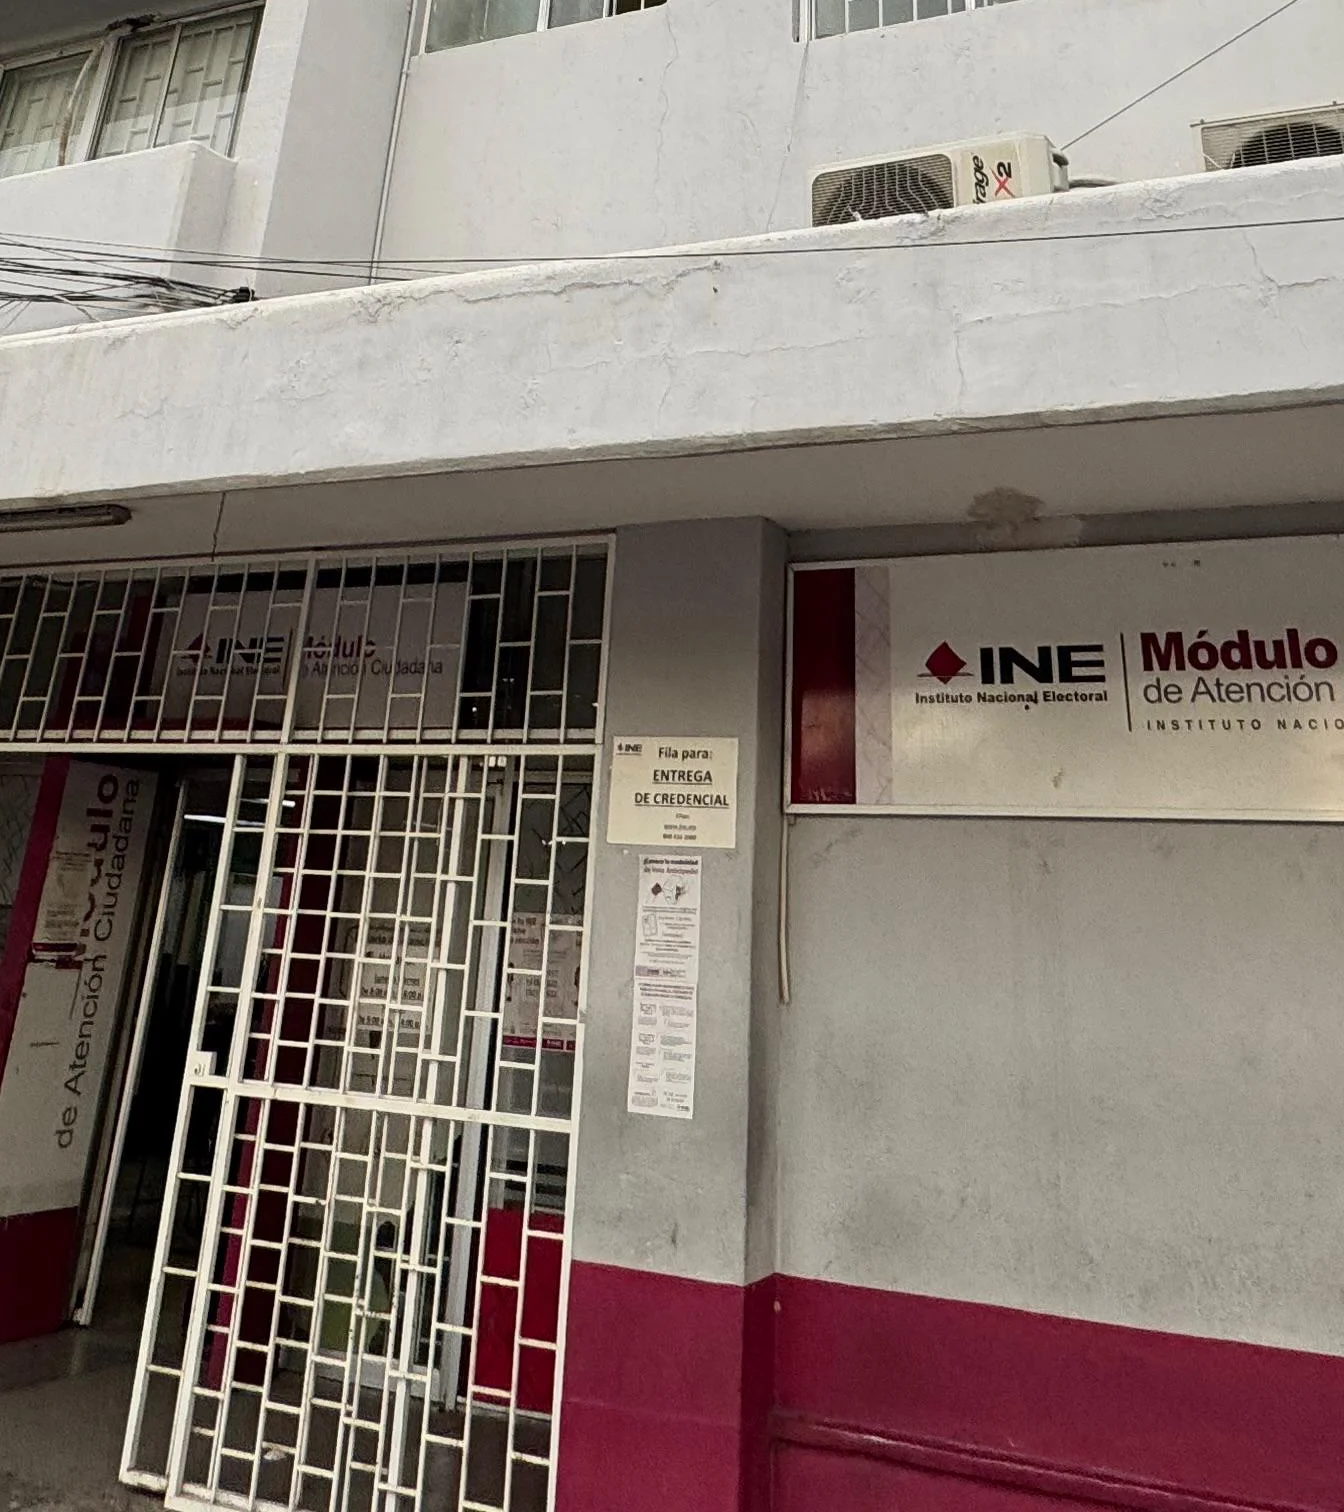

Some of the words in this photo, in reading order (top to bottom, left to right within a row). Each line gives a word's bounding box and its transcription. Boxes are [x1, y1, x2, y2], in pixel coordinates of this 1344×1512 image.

[972, 155, 989, 204] rage
[216, 636, 284, 664] INE
[979, 644, 1106, 685] INE
[1139, 628, 1338, 672] Módulo
[915, 691, 973, 704] Instituto
[976, 690, 1038, 705] Nacional
[1042, 690, 1108, 703] Electoral
[1143, 676, 1183, 704] de
[1191, 674, 1335, 704] Atención
[1146, 718, 1262, 731] INSTITUTO
[658, 747, 679, 759] Fila
[681, 749, 713, 761] para:
[652, 769, 713, 783] ENTREGA
[634, 792, 651, 804] DE
[653, 792, 730, 807] CREDENCIAL
[94, 779, 140, 942] Ciudadana
[64, 954, 107, 1096] Atención
[55, 1105, 78, 1149] de
